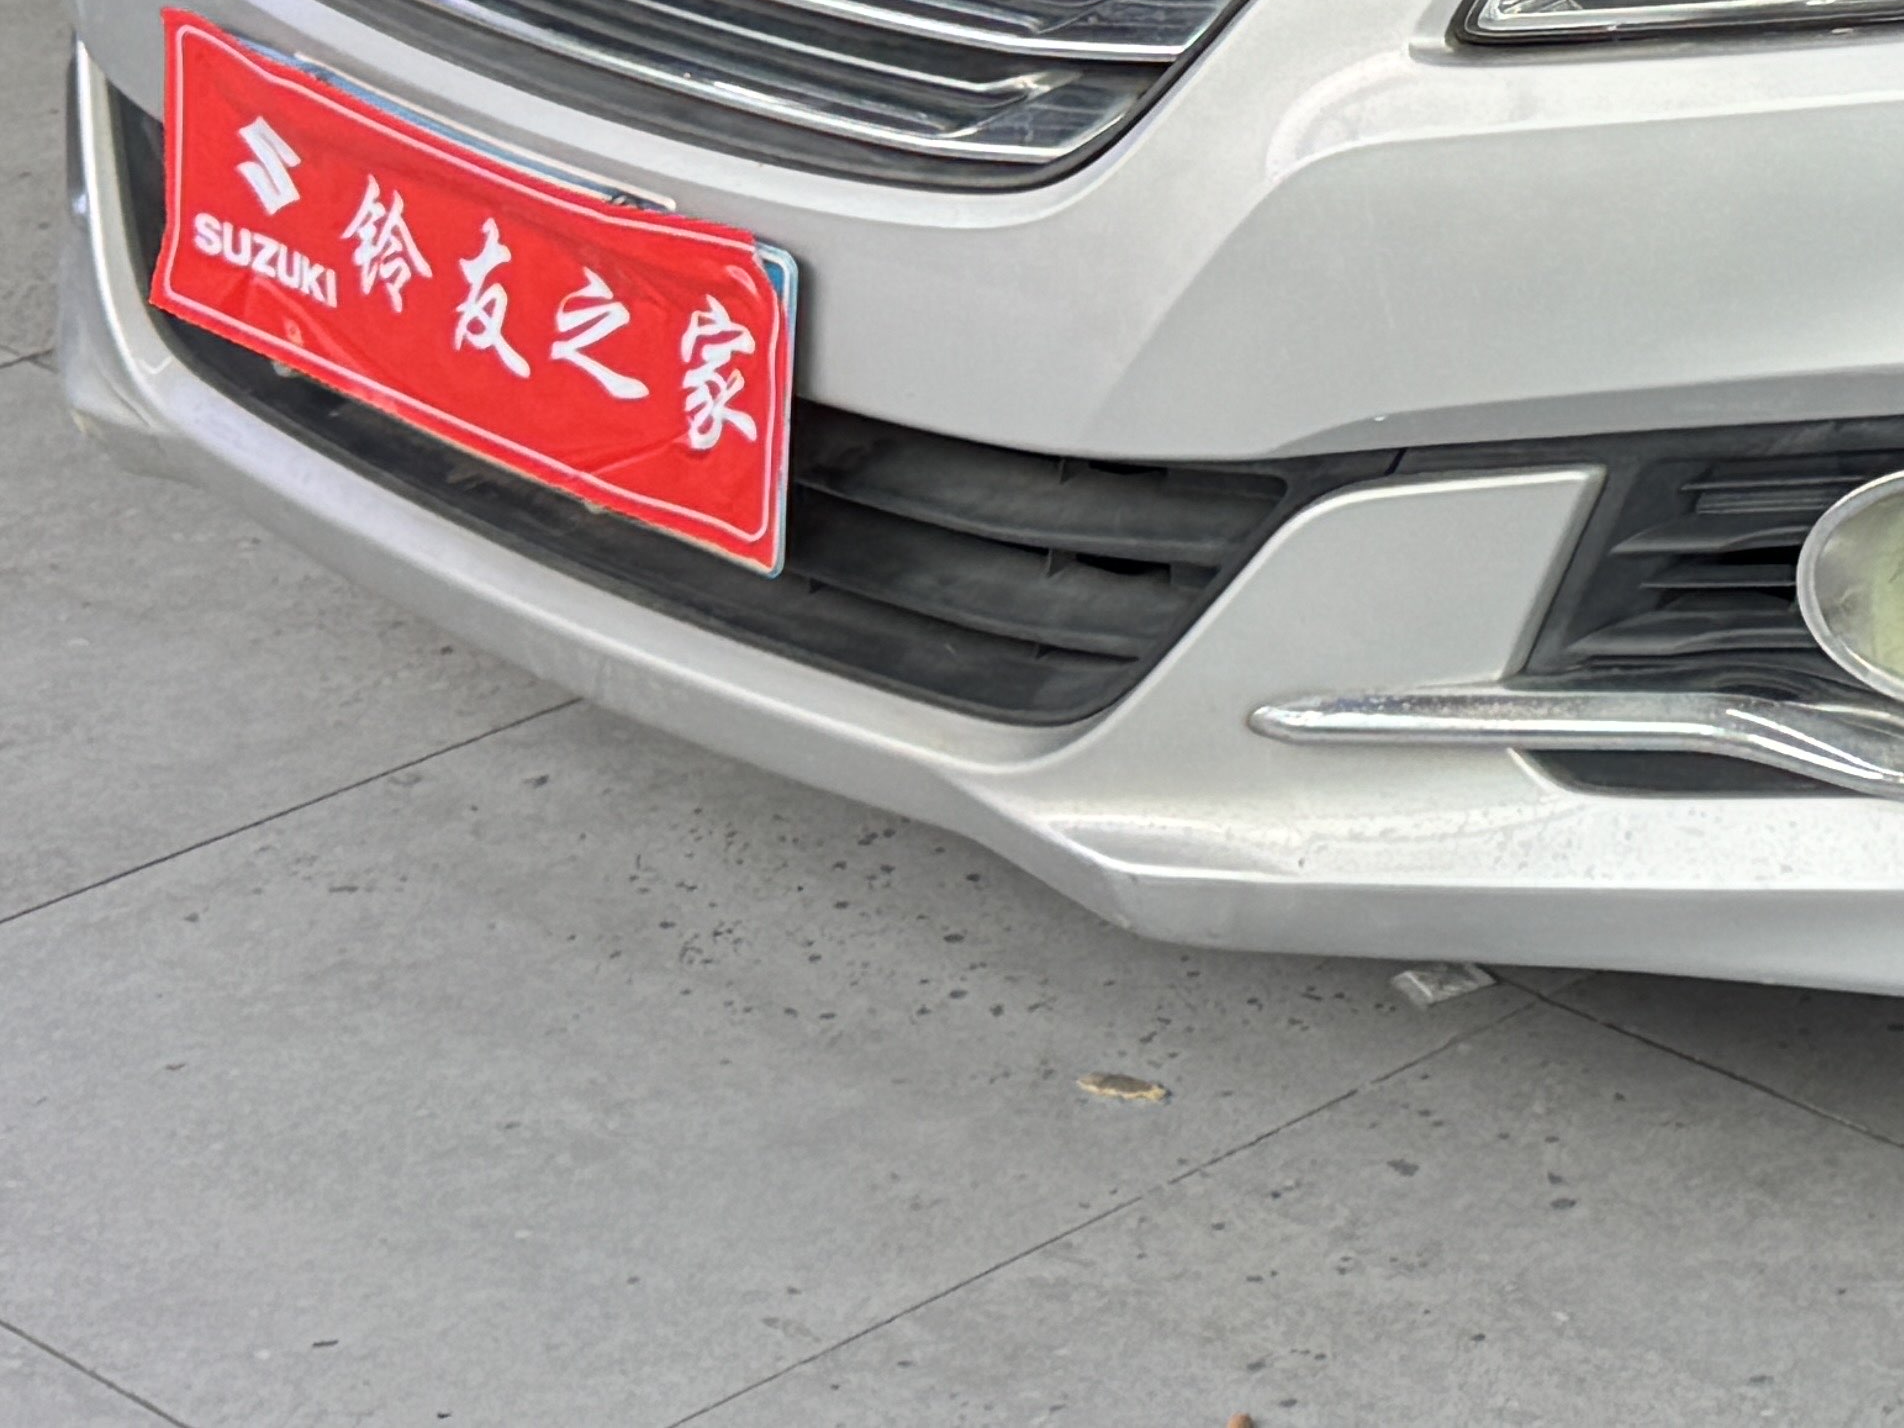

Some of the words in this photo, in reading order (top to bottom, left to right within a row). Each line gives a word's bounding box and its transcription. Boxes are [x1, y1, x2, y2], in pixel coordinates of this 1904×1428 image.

[192, 210, 338, 309] SUZUKI
[340, 173, 758, 451] 铃友之家
